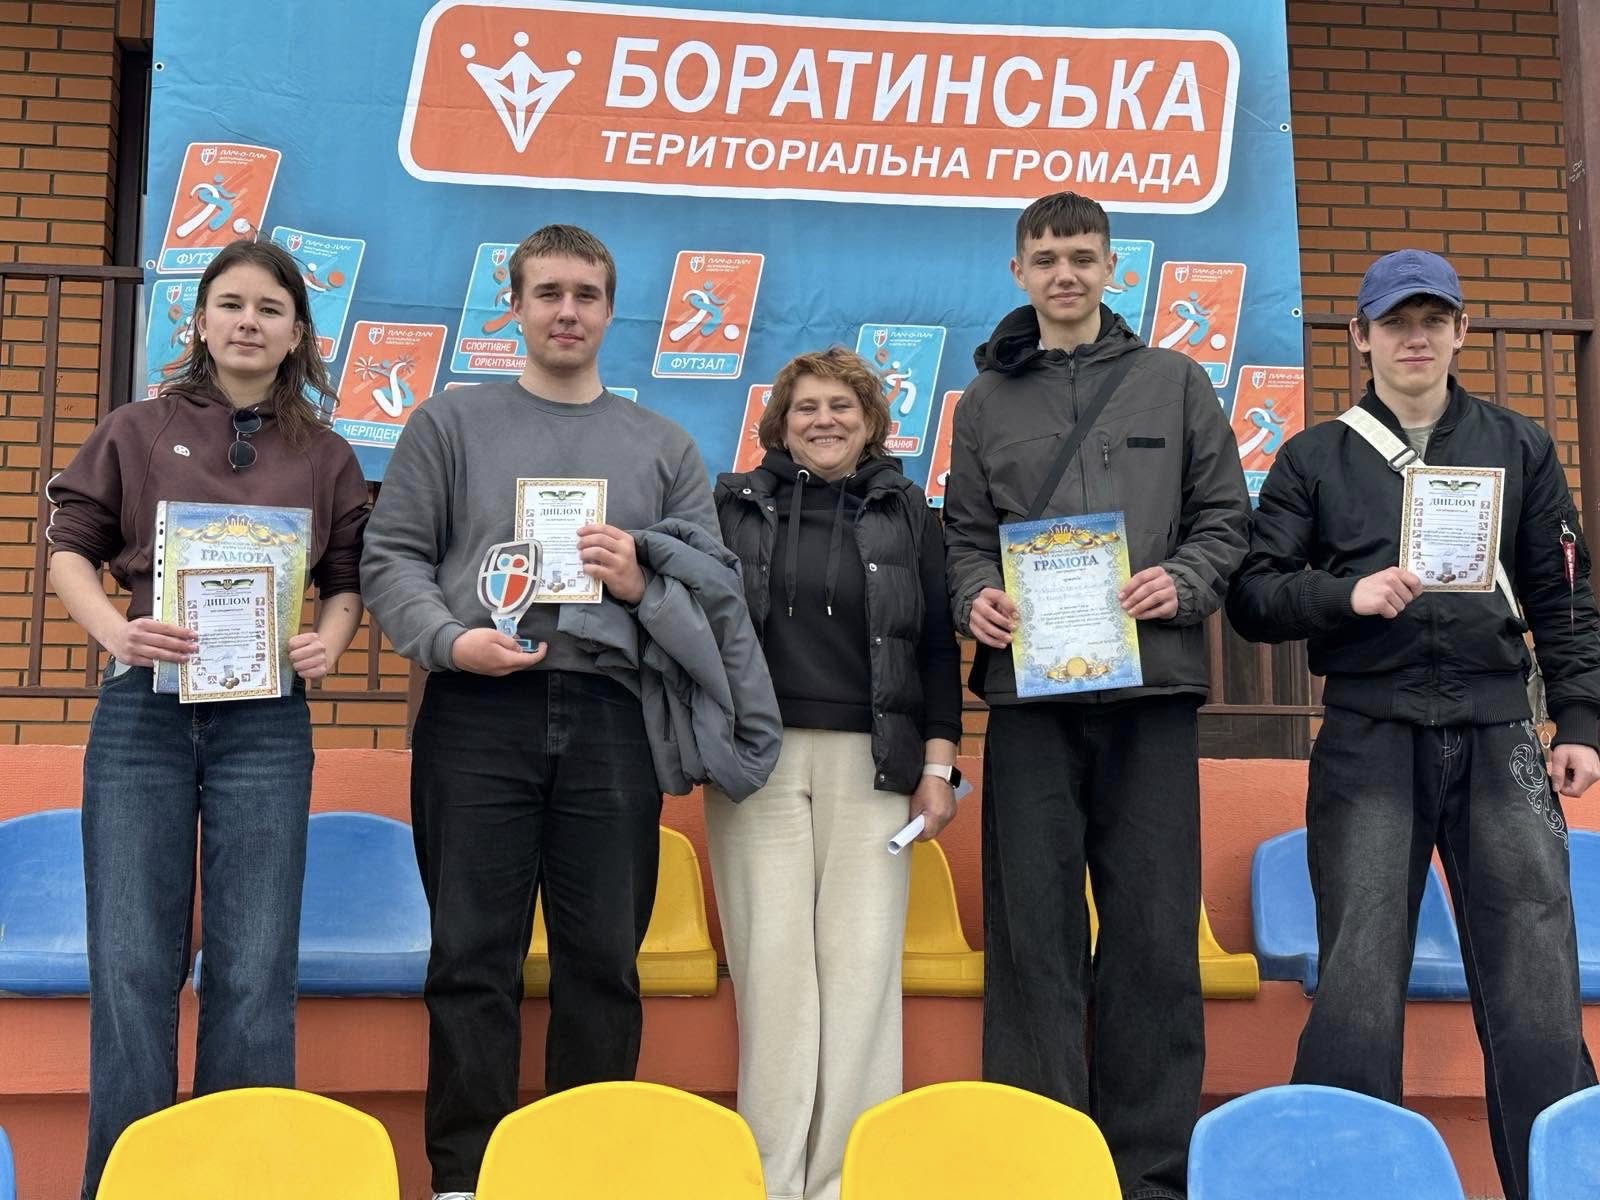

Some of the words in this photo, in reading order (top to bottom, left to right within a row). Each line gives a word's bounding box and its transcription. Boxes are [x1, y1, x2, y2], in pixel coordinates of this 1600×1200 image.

[605, 37, 1206, 132] БОРАТИНСЬКА
[601, 130, 971, 179] ТЕРИТОРІАЛЬНА
[986, 147, 1202, 193] ГРОМАДА
[176, 252, 213, 265] ФУТЗ
[465, 341, 511, 352] СПОРТИВНЕ
[474, 357, 527, 368] ОРІЄНТУВАНН
[671, 357, 726, 370] ФУТЗАЛ
[343, 424, 399, 441] ЧЕРЛІДЕН
[1429, 498, 1476, 507] ДИПЛОМ
[540, 508, 582, 517] ДИПЛОМ
[201, 548, 274, 565] ГРАМОТА
[1033, 555, 1099, 572] ГРАМОТА
[203, 597, 250, 608] ДИПЛОМ
